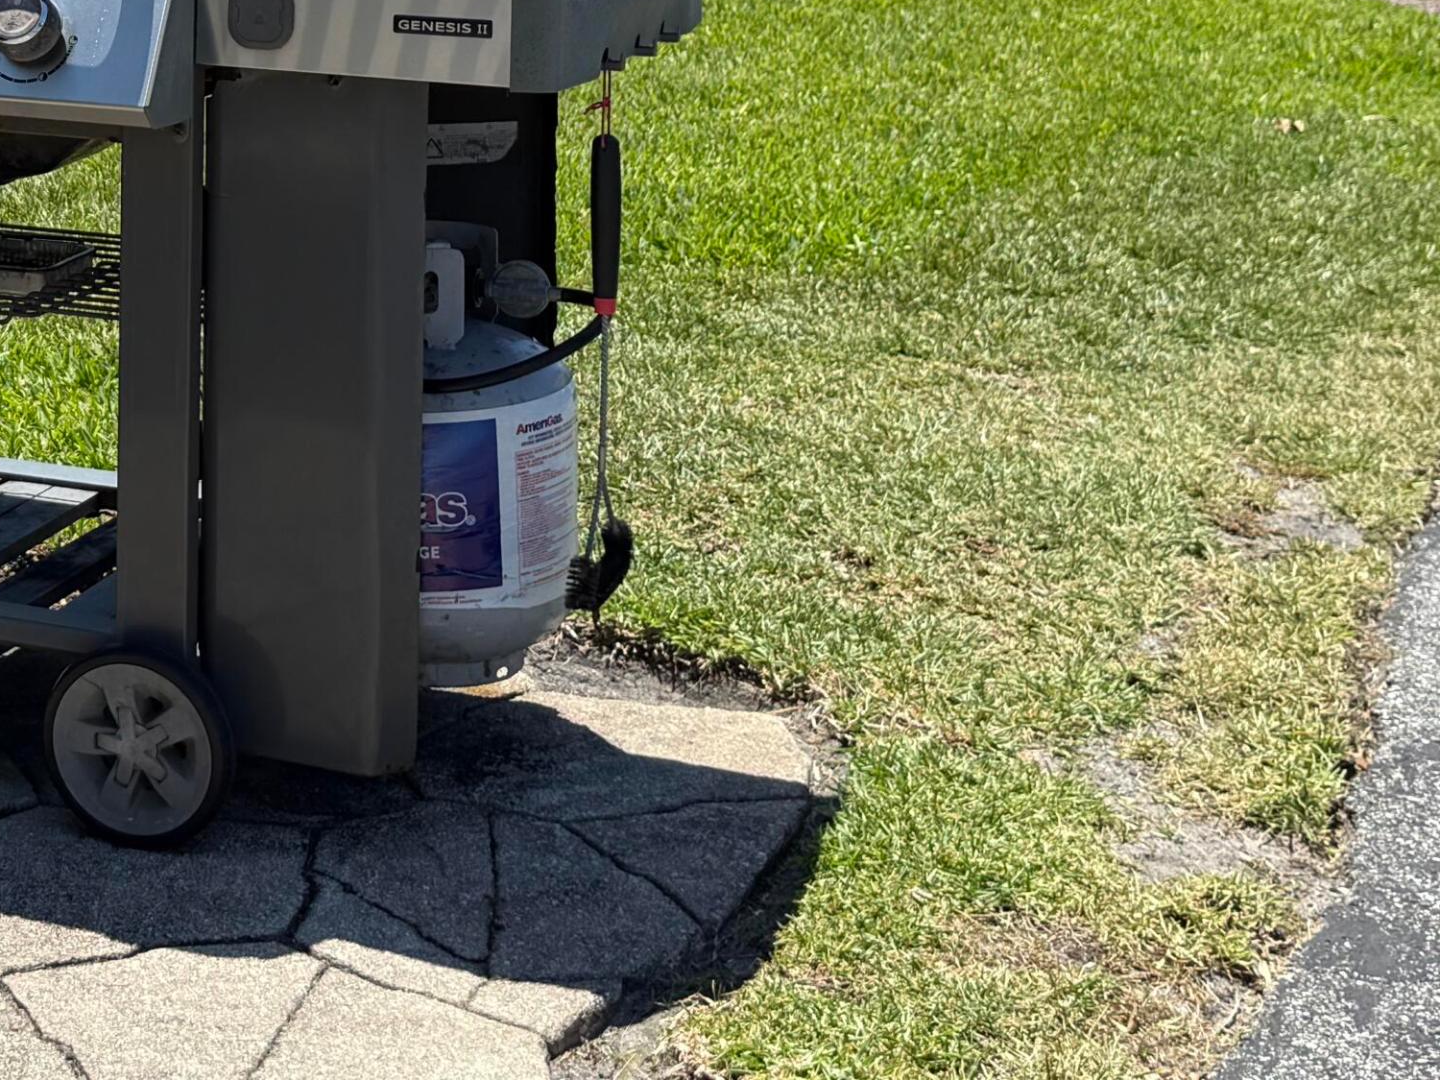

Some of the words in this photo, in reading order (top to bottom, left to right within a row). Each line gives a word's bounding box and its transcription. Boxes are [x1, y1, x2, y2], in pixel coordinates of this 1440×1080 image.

[398, 19, 472, 34] GENESIS
[477, 23, 488, 35] II
[516, 413, 563, 435] AmeriGas
[420, 546, 441, 559] GE
